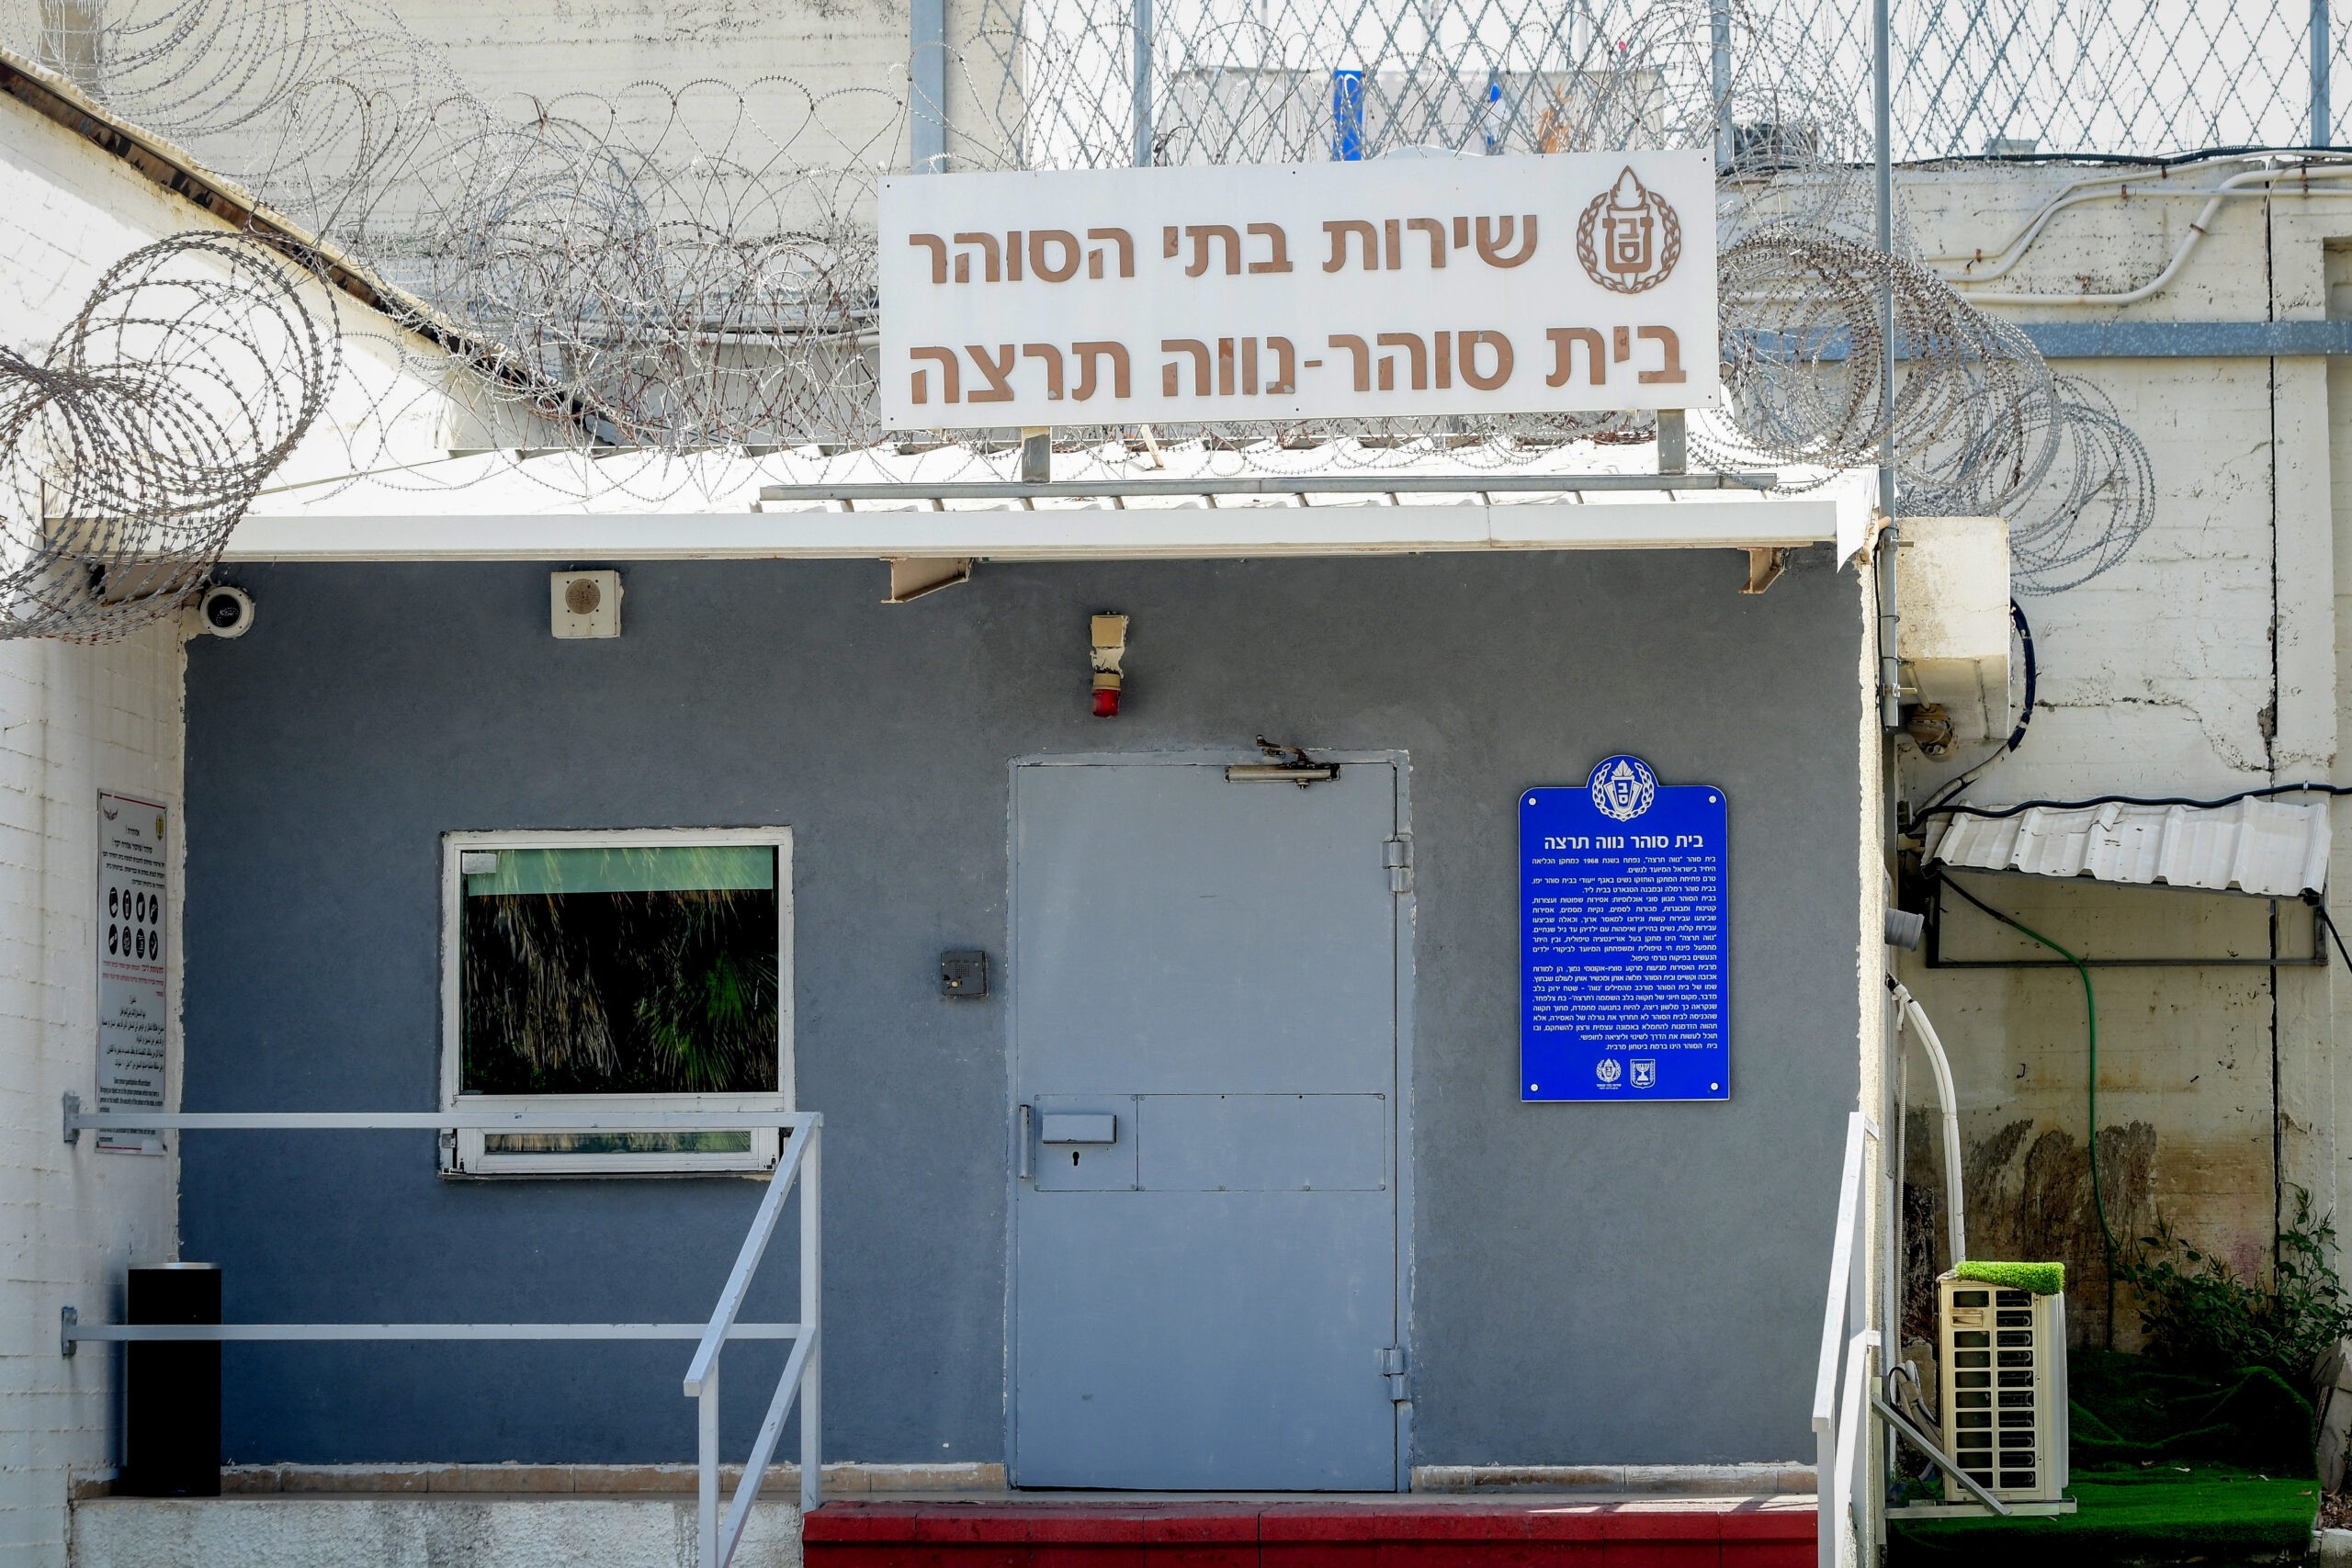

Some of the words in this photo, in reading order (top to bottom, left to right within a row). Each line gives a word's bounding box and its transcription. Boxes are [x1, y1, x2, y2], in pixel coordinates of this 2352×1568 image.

[909, 228, 1135, 285] הסוהר
[1163, 223, 1293, 277] בתי
[1322, 215, 1538, 274] שירות
[910, 341, 1130, 404] תרצה
[1161, 331, 1514, 399] סוהר-נווה
[1546, 325, 1687, 386] בית
[1544, 836, 1589, 850] תרצה
[1596, 836, 1624, 849] נווה
[1630, 835, 1669, 849] סוהר
[1674, 835, 1703, 848] בית
